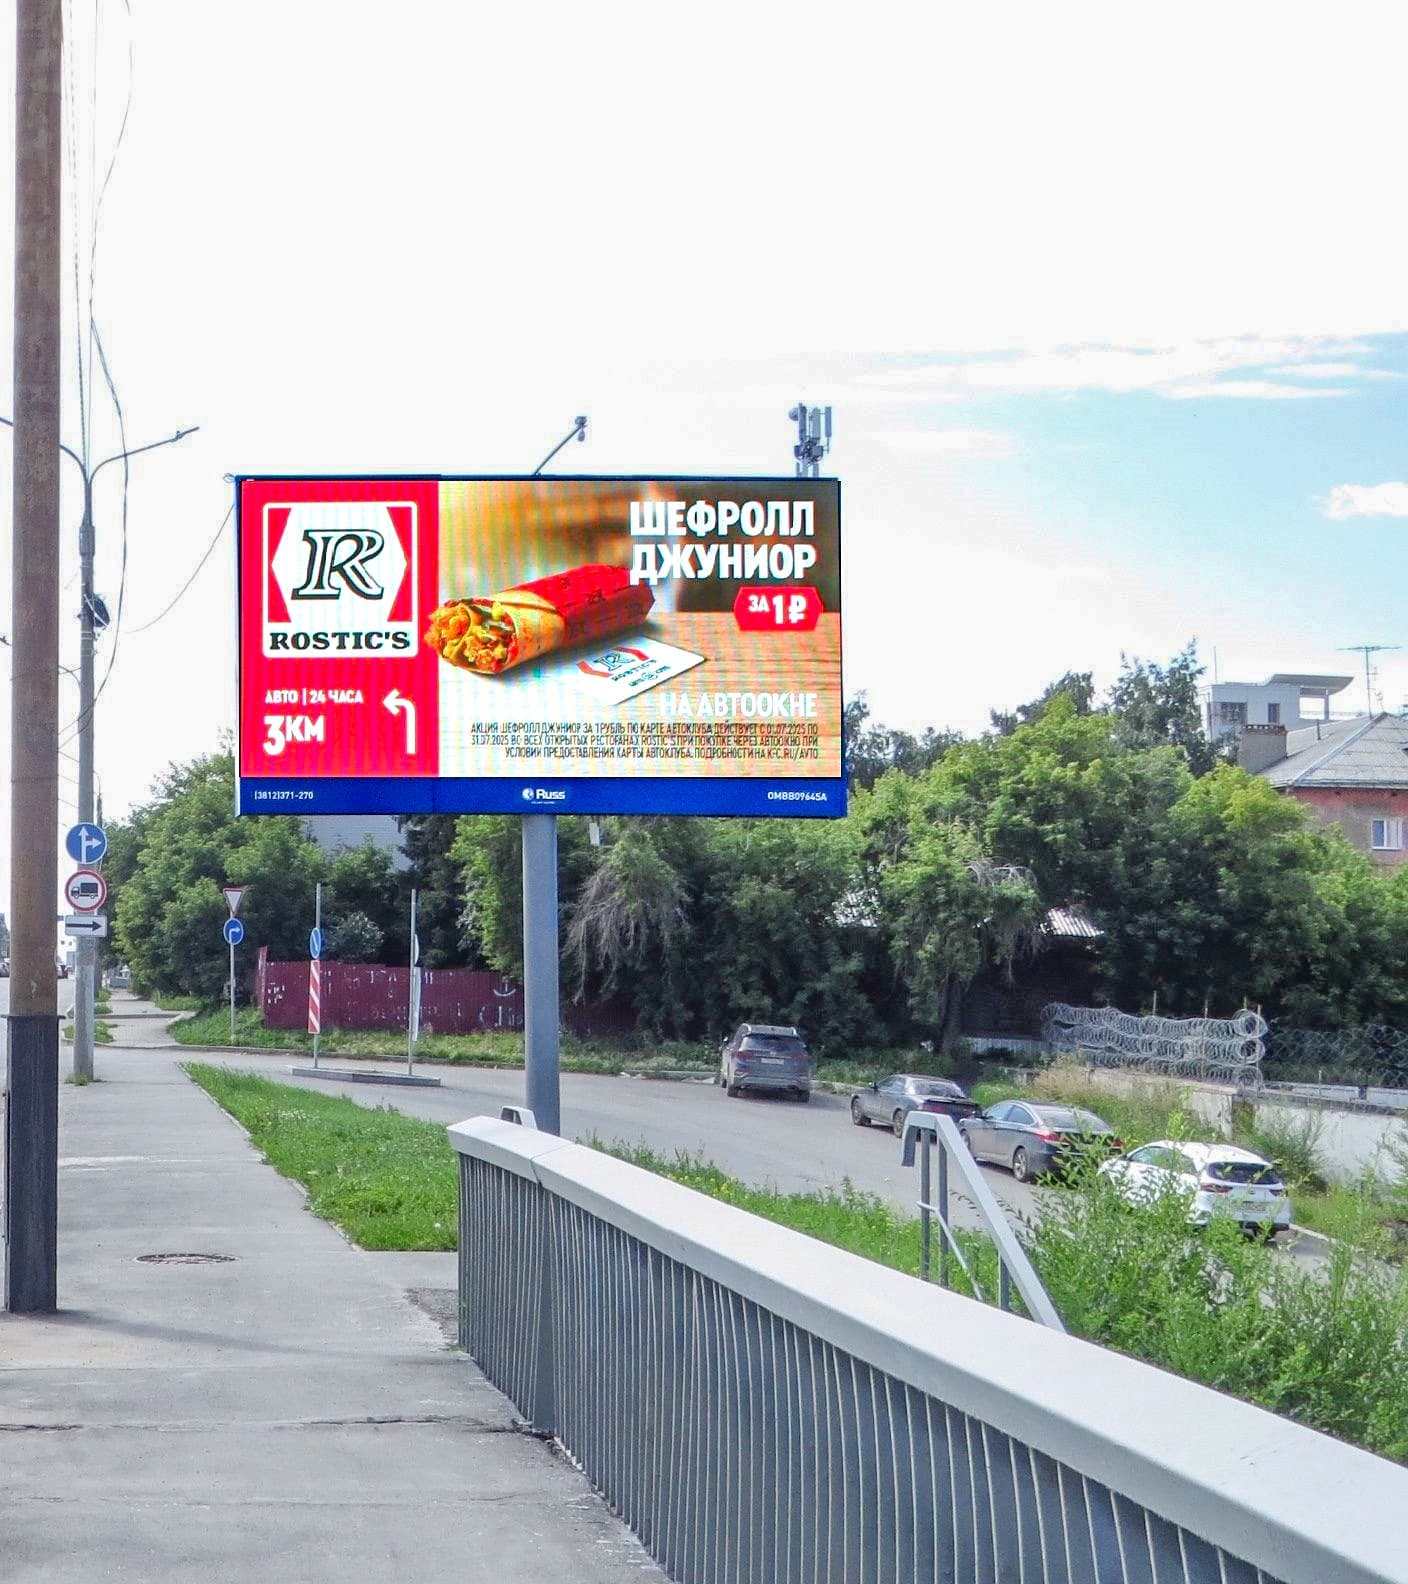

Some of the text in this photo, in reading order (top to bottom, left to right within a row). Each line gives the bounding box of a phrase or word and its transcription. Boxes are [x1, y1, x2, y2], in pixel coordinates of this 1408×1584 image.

[629, 500, 815, 537] ШЕФРОЛЛ
[290, 528, 386, 601] R
[629, 542, 818, 586] ДЖУНИОР
[747, 594, 771, 613] ЗА
[268, 630, 412, 651] ROSTIC'S
[264, 688, 365, 705] АВТО 24 ЧАСА
[659, 692, 818, 718] НА АВТООКНЕ
[263, 714, 326, 757] 3КМ
[470, 721, 499, 735] АКЦИЯ
[500, 721, 541, 734] ШЕФРОЛЛ
[541, 721, 581, 736] ДЖУНИОР
[583, 722, 593, 734] ЗА
[640, 722, 665, 734] КАРТЕ
[807, 723, 819, 735] ПО
[523, 734, 543, 746] ВСЕХ
[802, 735, 819, 747] ПРИ
[616, 747, 644, 759] КАРТЫ
[253, 790, 315, 801] (3812)371-270
[535, 788, 567, 800] Russ
